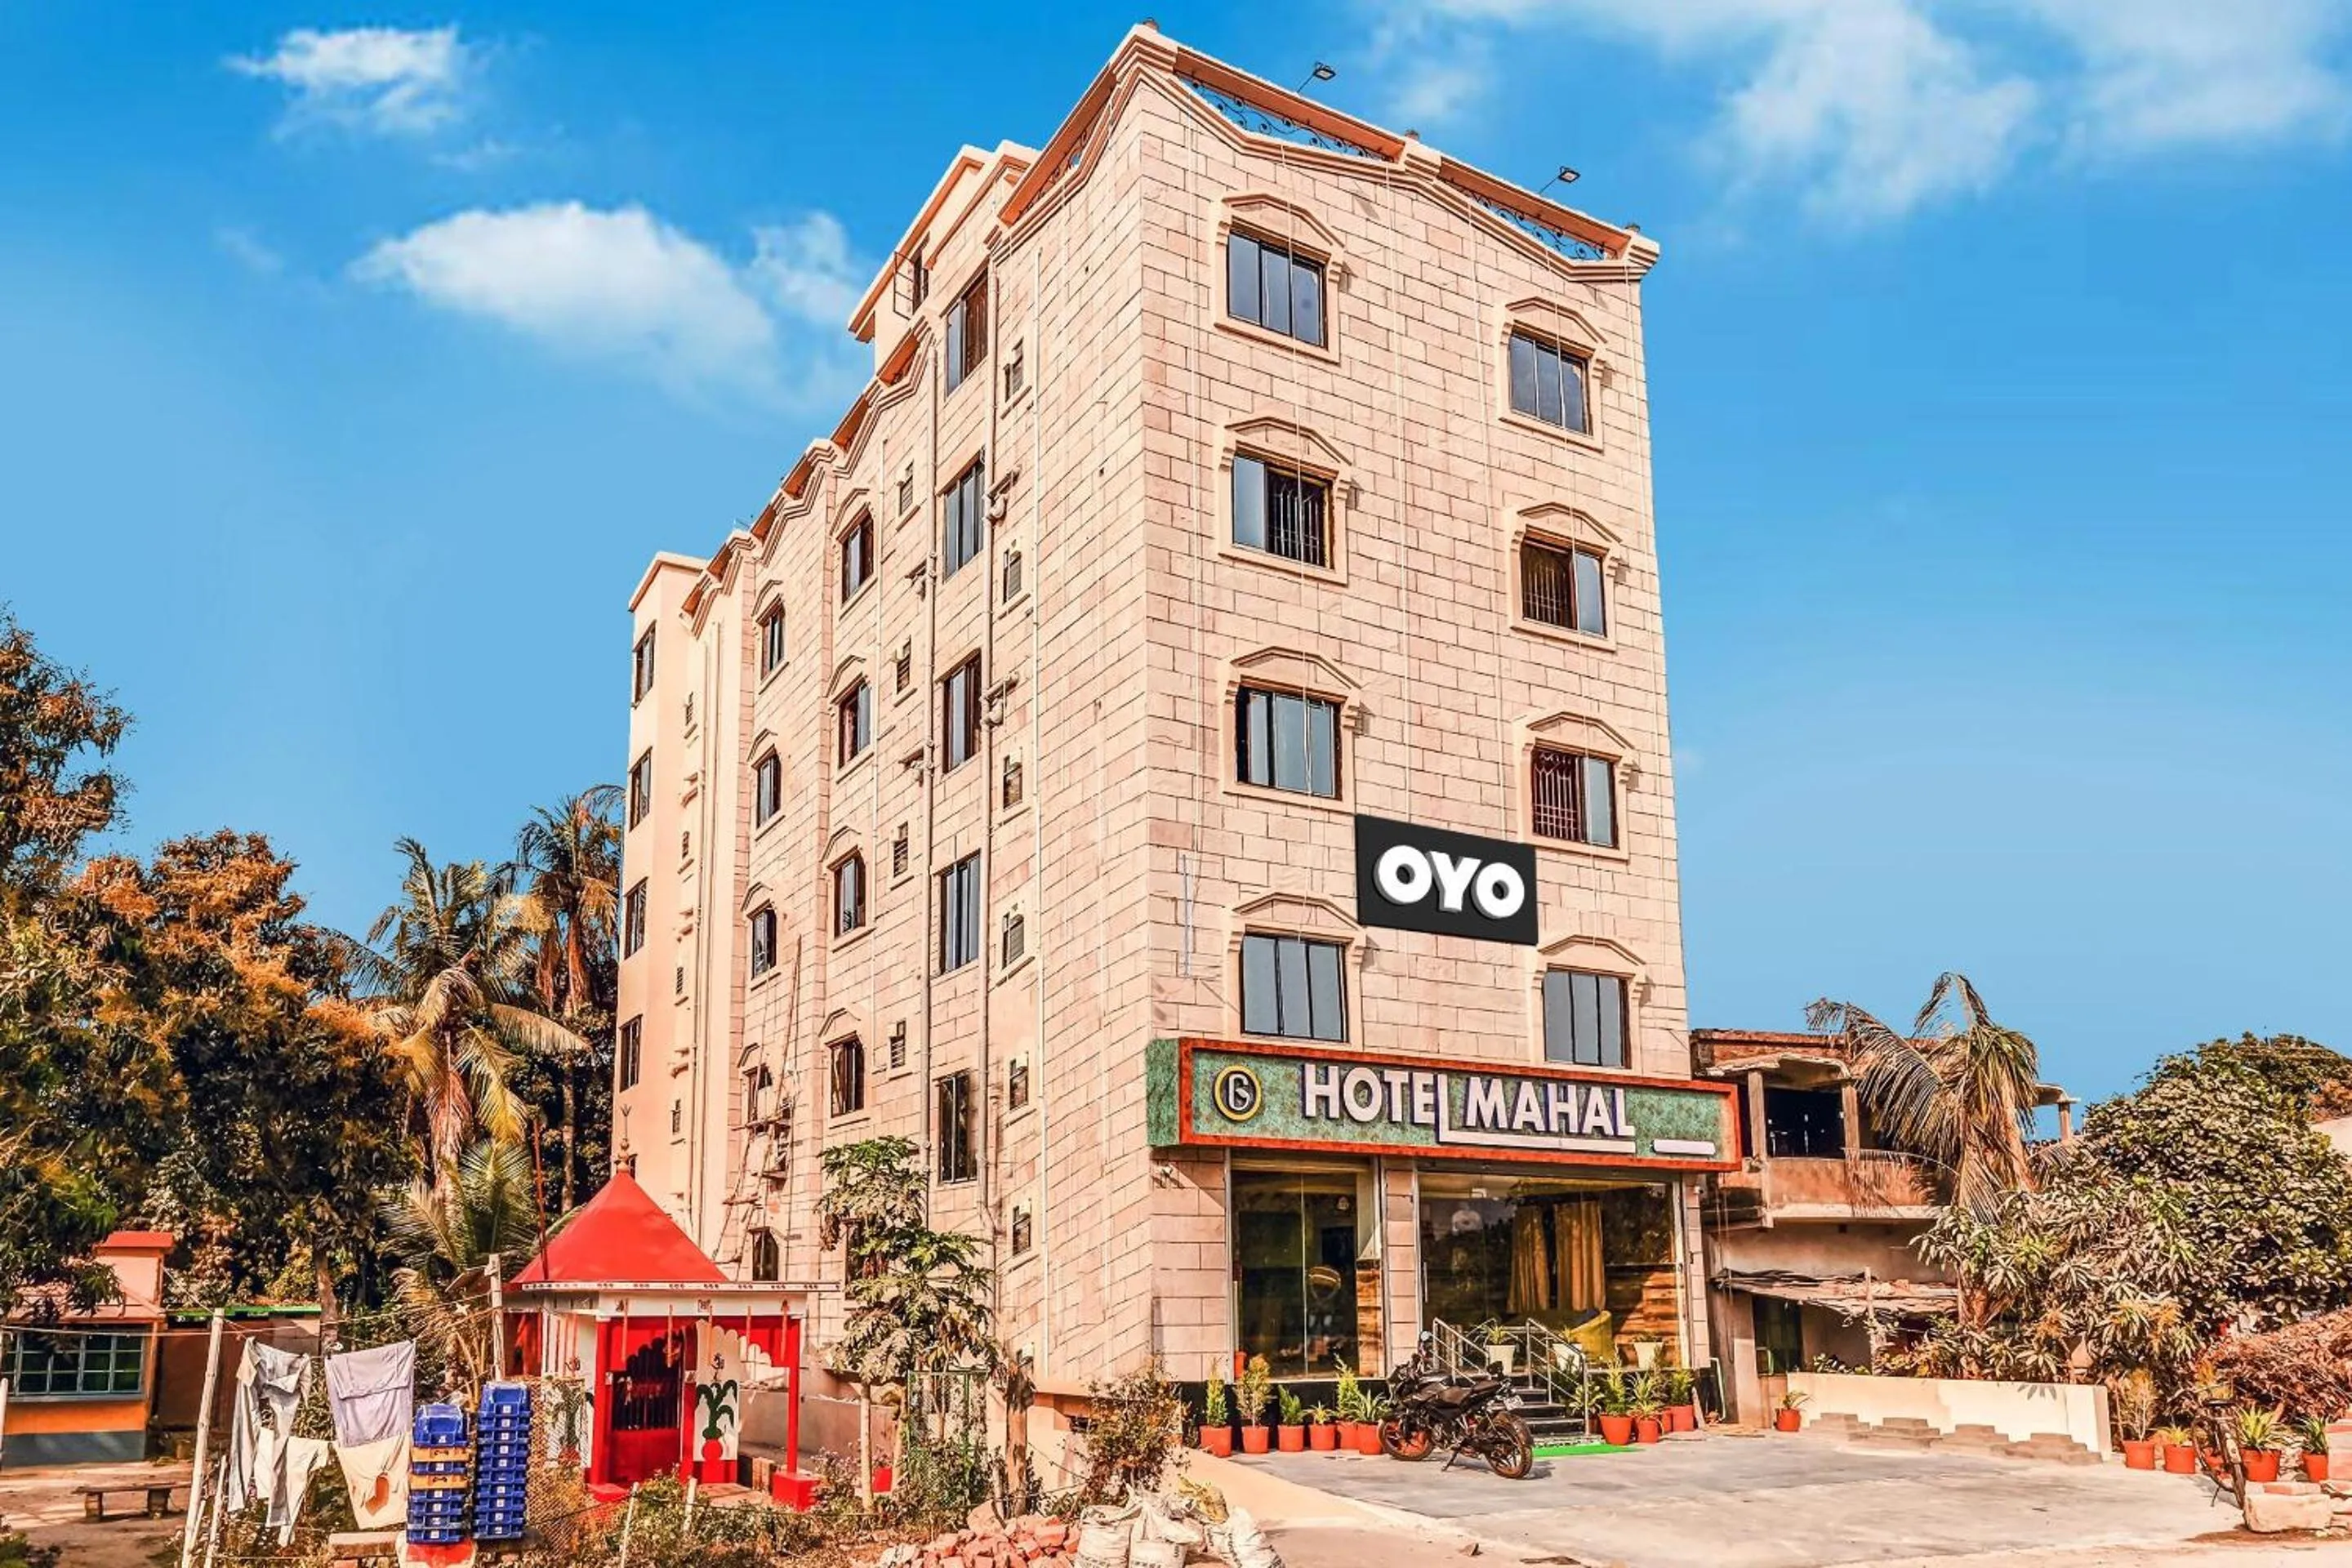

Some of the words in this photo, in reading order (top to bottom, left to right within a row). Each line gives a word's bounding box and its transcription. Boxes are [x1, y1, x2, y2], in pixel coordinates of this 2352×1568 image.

[1374, 844, 1525, 919] OYO
[1303, 1063, 1453, 1142] HOTEL
[1468, 1076, 1635, 1137] MAHAL
